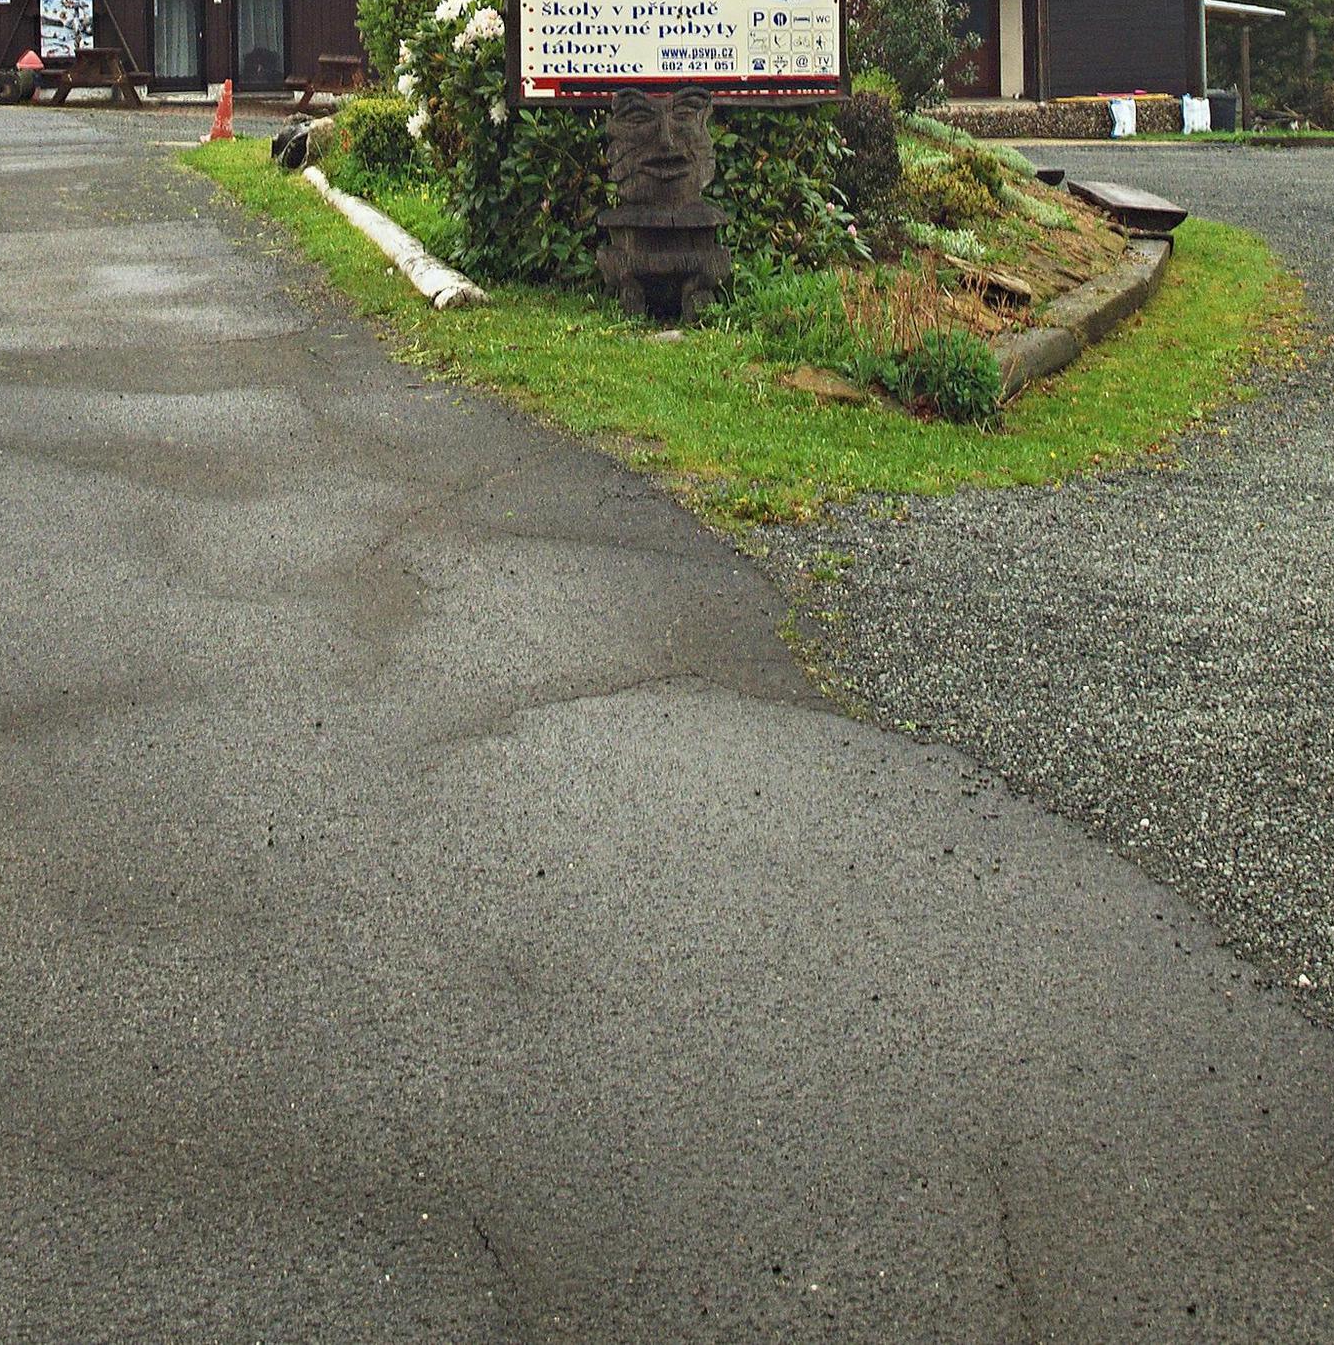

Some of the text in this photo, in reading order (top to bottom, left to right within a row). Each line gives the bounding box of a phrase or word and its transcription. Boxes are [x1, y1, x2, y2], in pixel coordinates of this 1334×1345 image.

[541, 1, 719, 20] školy v přírodě
[753, 11, 765, 27] P
[815, 14, 831, 23] WC
[541, 20, 737, 38] ozdravné pobyty
[542, 40, 621, 58] tábory
[661, 47, 734, 60] www.psvp.cz
[542, 60, 644, 74] rekreace
[661, 61, 734, 71] 602 421 051
[817, 56, 830, 65] TV
